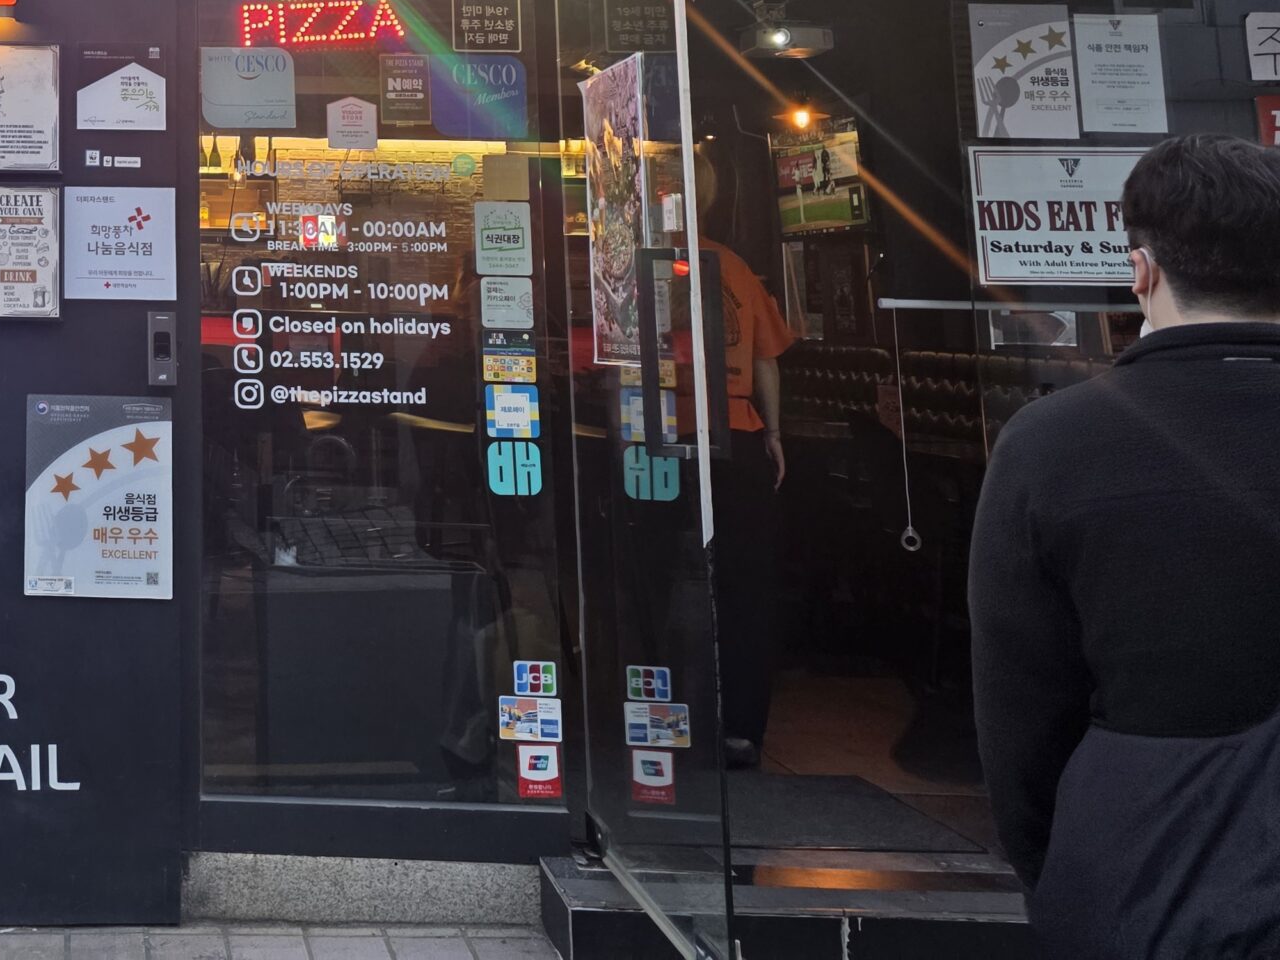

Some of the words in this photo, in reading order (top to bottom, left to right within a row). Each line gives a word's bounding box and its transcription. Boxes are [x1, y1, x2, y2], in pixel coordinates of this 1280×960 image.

[1087, 43, 1102, 53] 식품
[1104, 44, 1121, 53] 안전
[1124, 43, 1149, 54] 책임자
[235, 54, 287, 73] CESCO
[452, 63, 517, 86] CESCO
[1044, 68, 1068, 77] 음식점
[387, 78, 423, 90] N예약
[1030, 76, 1069, 87] 위생등급
[473, 90, 519, 106] Members
[1024, 91, 1046, 102] 매우
[1048, 91, 1071, 102] 우수
[237, 161, 302, 178] HOURS
[307, 162, 335, 178] OF
[340, 163, 451, 180] OPERATION
[0, 195, 43, 206] CREATE
[0, 207, 19, 216] YOUR
[23, 207, 44, 216] OWN
[267, 202, 353, 216] WEEKDAYS
[977, 200, 1042, 231] KIDS
[1046, 200, 1097, 232] EAT
[90, 225, 134, 239] 희망풍차
[363, 220, 446, 238] 00:00AM
[267, 241, 308, 251] BREAK
[310, 242, 338, 251] TIME
[485, 234, 520, 244] 식권대장
[88, 242, 153, 256] 나눔음식점
[990, 240, 1074, 256] Saturday
[1080, 241, 1093, 254] &
[3, 272, 32, 281] DRINK
[270, 264, 358, 278] WEEKENDS
[280, 282, 349, 300] 1:00PM
[270, 316, 336, 334] Closed
[342, 320, 366, 334] on
[370, 317, 451, 339] holidays
[270, 351, 384, 369] 02.553.1529
[271, 385, 427, 406] @thepizzastand
[124, 493, 157, 505] 음식점
[102, 506, 159, 522] 위생등급
[93, 527, 124, 544] 매우
[128, 527, 159, 545] 우수
[101, 550, 159, 560] EXCELLENT
[517, 673, 553, 684] JCB
